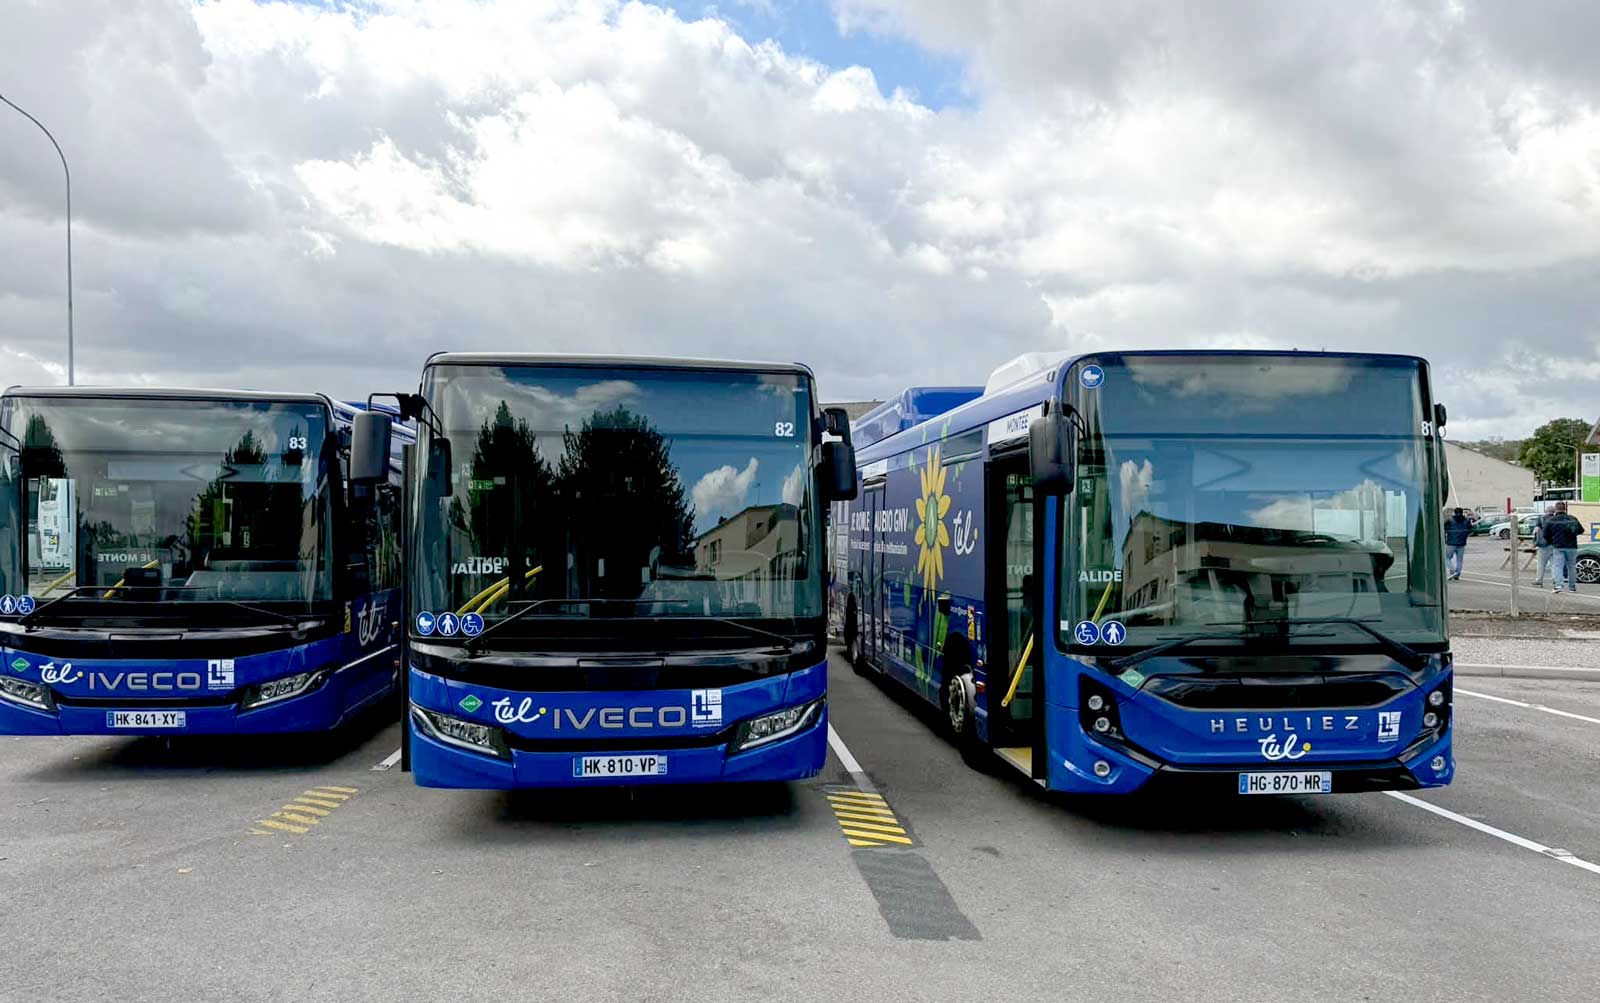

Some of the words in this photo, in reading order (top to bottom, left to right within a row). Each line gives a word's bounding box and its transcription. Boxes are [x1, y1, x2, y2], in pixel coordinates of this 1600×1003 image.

[775, 422, 794, 437] 82
[289, 436, 307, 450] 83
[1078, 570, 1122, 582] ALIDE
[88, 671, 201, 690] IVECO
[491, 695, 546, 724] tul
[552, 705, 686, 730] IVECO
[115, 712, 177, 726] HK-841-XY
[1209, 715, 1360, 733] HEULIEZ
[584, 757, 657, 775] HK-810-VP
[1249, 774, 1321, 792] HG-870-MR
